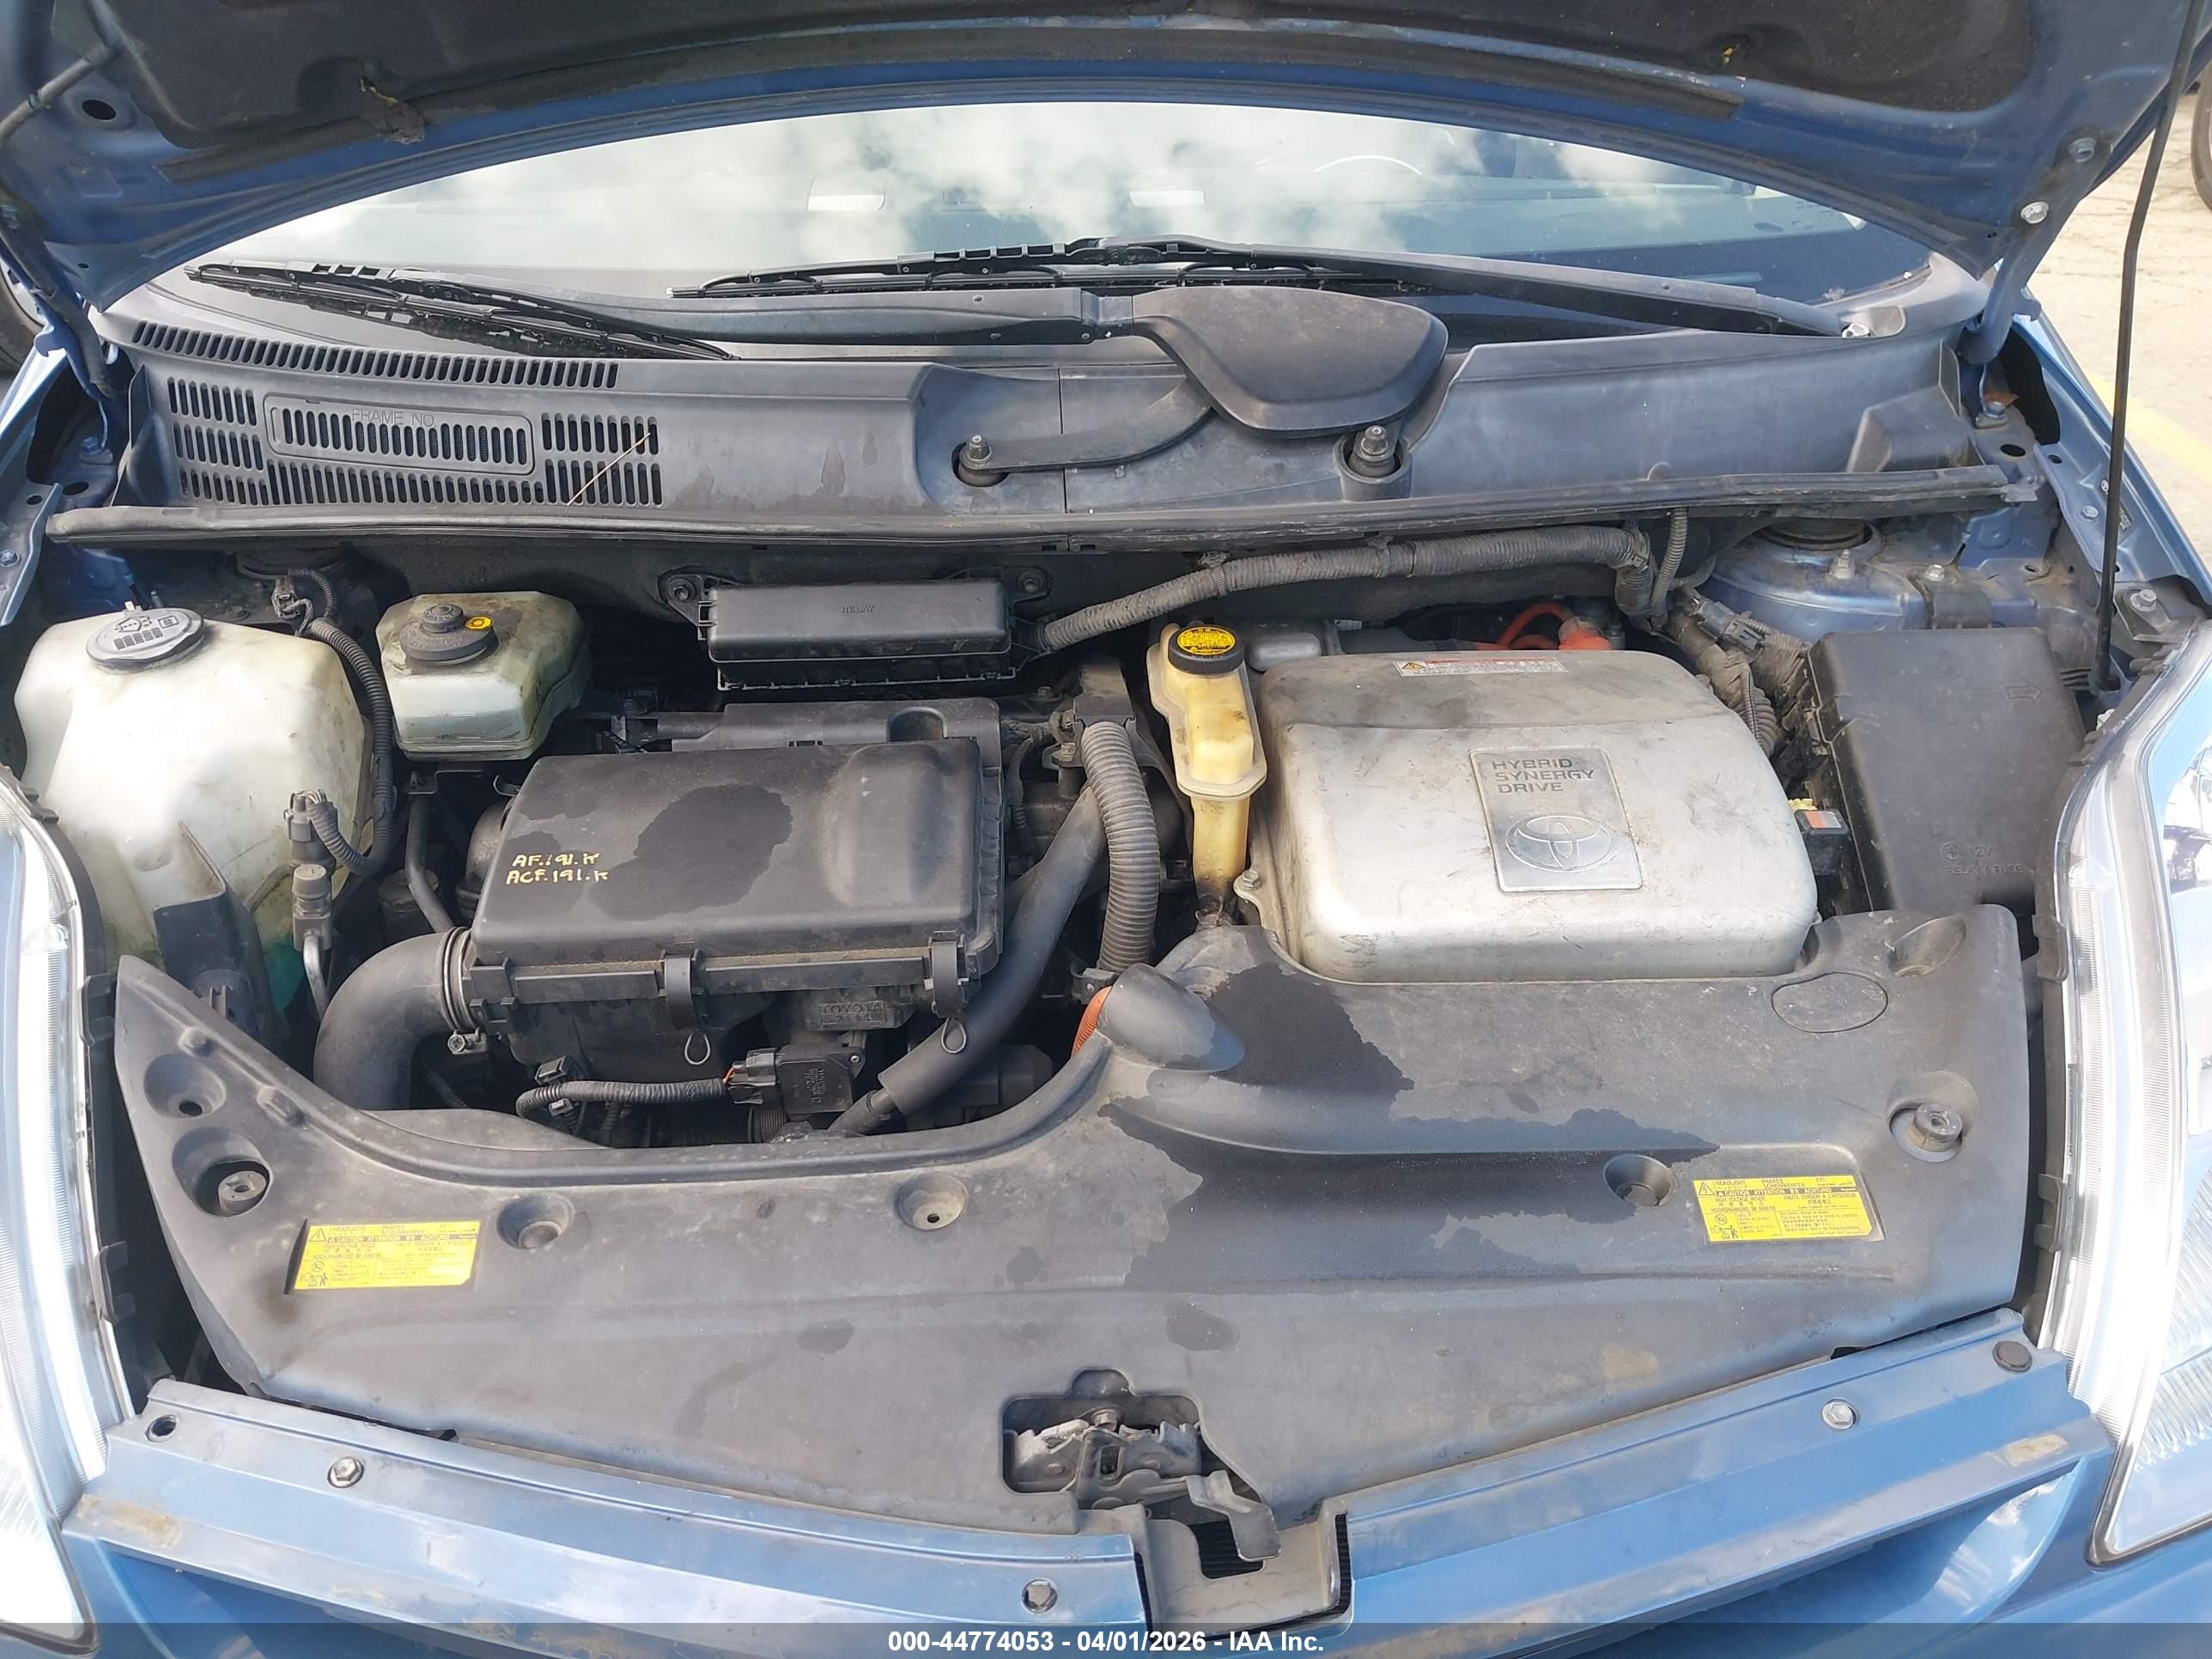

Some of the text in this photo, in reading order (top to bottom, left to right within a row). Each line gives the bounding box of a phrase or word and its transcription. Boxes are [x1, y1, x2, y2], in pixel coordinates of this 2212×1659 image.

[352, 408, 436, 428] FRAME NO.
[1492, 758, 1573, 769] HYBRID
[1496, 769, 1595, 781] SYNERGY
[1498, 781, 1564, 793] DRIVE
[1993, 864, 2023, 874] FUSE
[823, 1003, 881, 1014] TOYOTA
